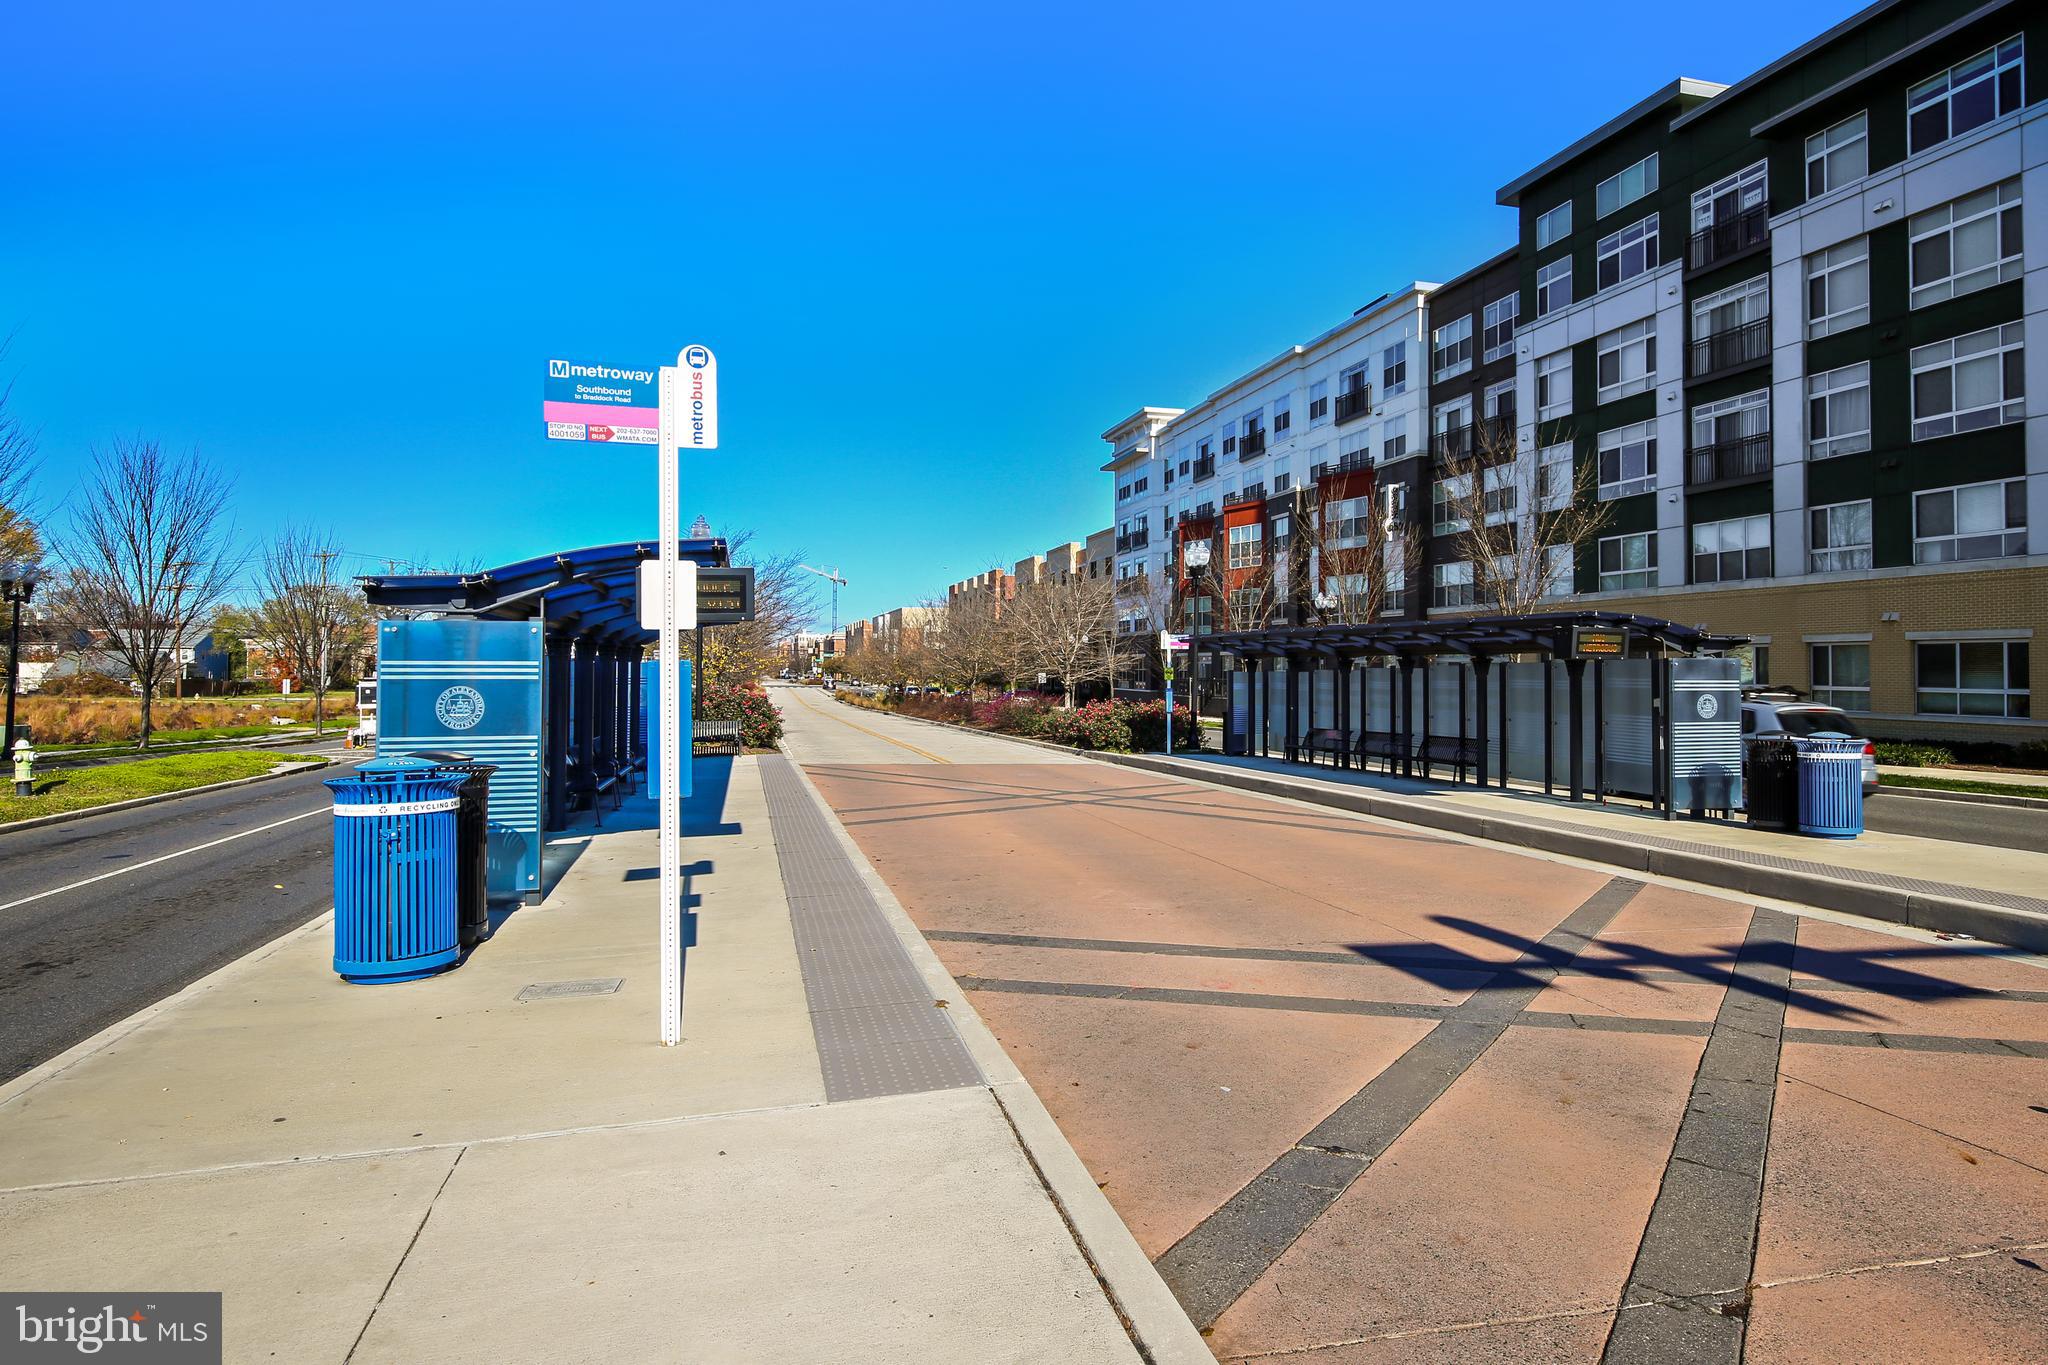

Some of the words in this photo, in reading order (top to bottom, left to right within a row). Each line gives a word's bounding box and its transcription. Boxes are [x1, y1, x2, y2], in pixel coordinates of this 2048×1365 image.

[571, 365, 654, 384] metroway
[576, 384, 632, 396] Southbound
[583, 394, 613, 402] Braddock
[690, 372, 704, 444] metrobus
[549, 430, 585, 439] 4001059
[616, 428, 657, 436] 202-637-7000
[616, 435, 657, 443] WMATA.COM
[400, 802, 449, 812] RECYCLING
